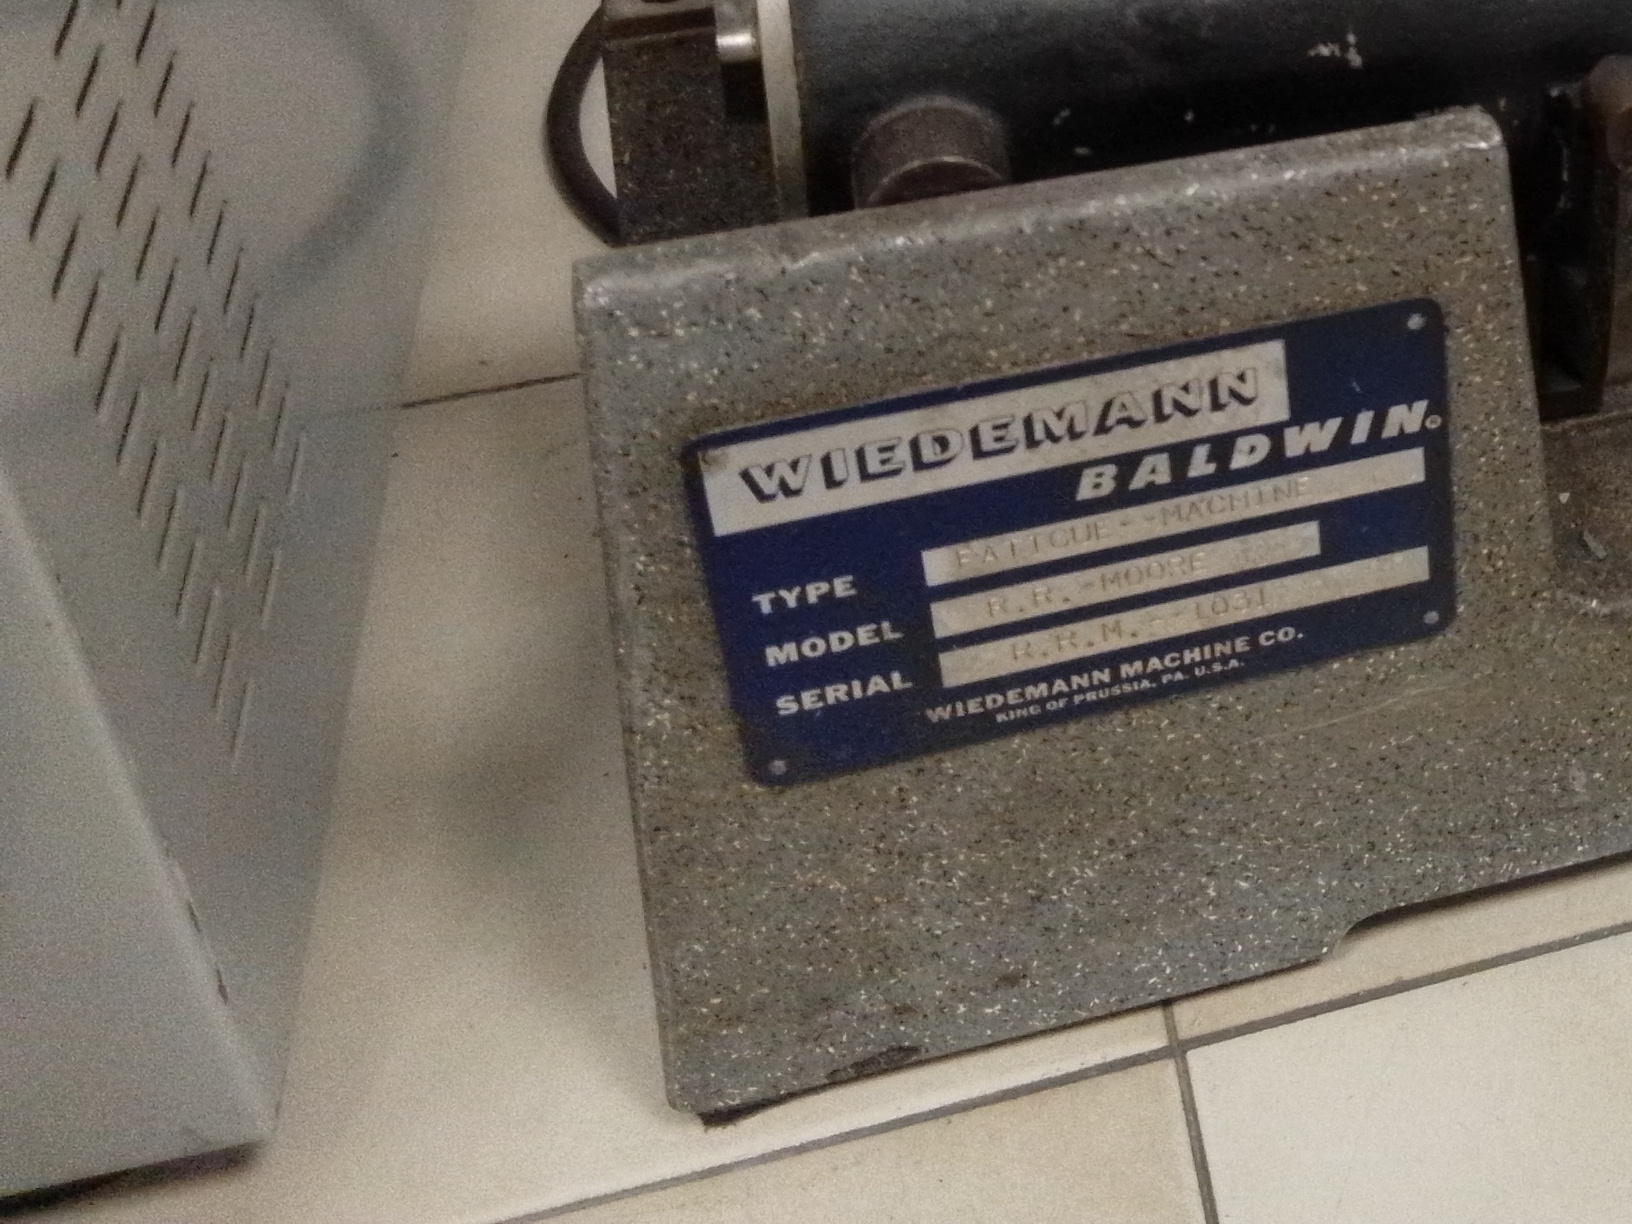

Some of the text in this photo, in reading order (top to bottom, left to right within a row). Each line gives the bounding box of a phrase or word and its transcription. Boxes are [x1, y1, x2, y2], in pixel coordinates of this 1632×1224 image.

[739, 367, 1259, 504] WIEDEMANN
[752, 575, 857, 615] TYPE
[764, 620, 904, 667] MODEL
[776, 670, 913, 716] SERIAL
[925, 626, 1304, 723] WIEDEMANN MACHINE CO.
